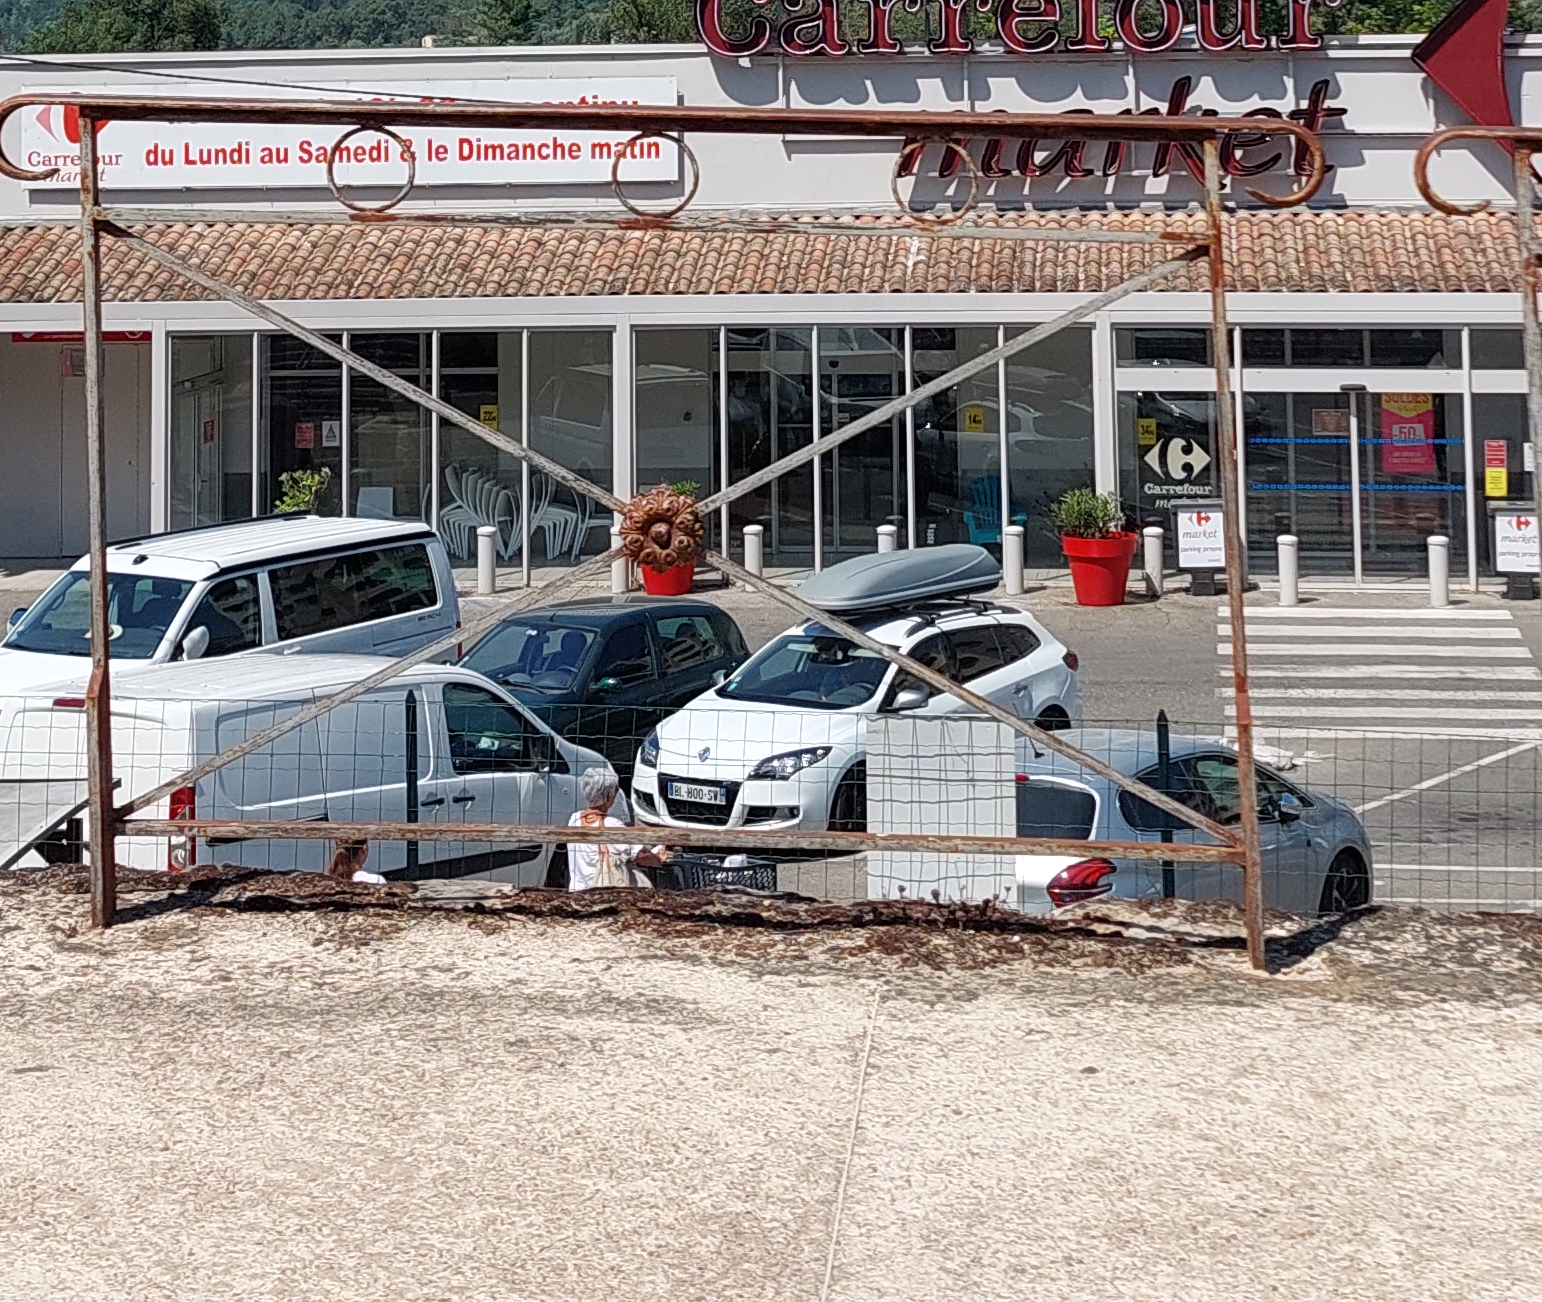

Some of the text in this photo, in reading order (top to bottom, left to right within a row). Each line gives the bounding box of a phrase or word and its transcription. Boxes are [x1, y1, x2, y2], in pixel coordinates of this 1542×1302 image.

[145, 136, 660, 166] du Lundi au Samedi & le Dimanche matin
[27, 151, 123, 168] Carreur
[1144, 483, 1213, 495] Carrefour
[1182, 529, 1218, 539] market
[1500, 534, 1538, 544] market
